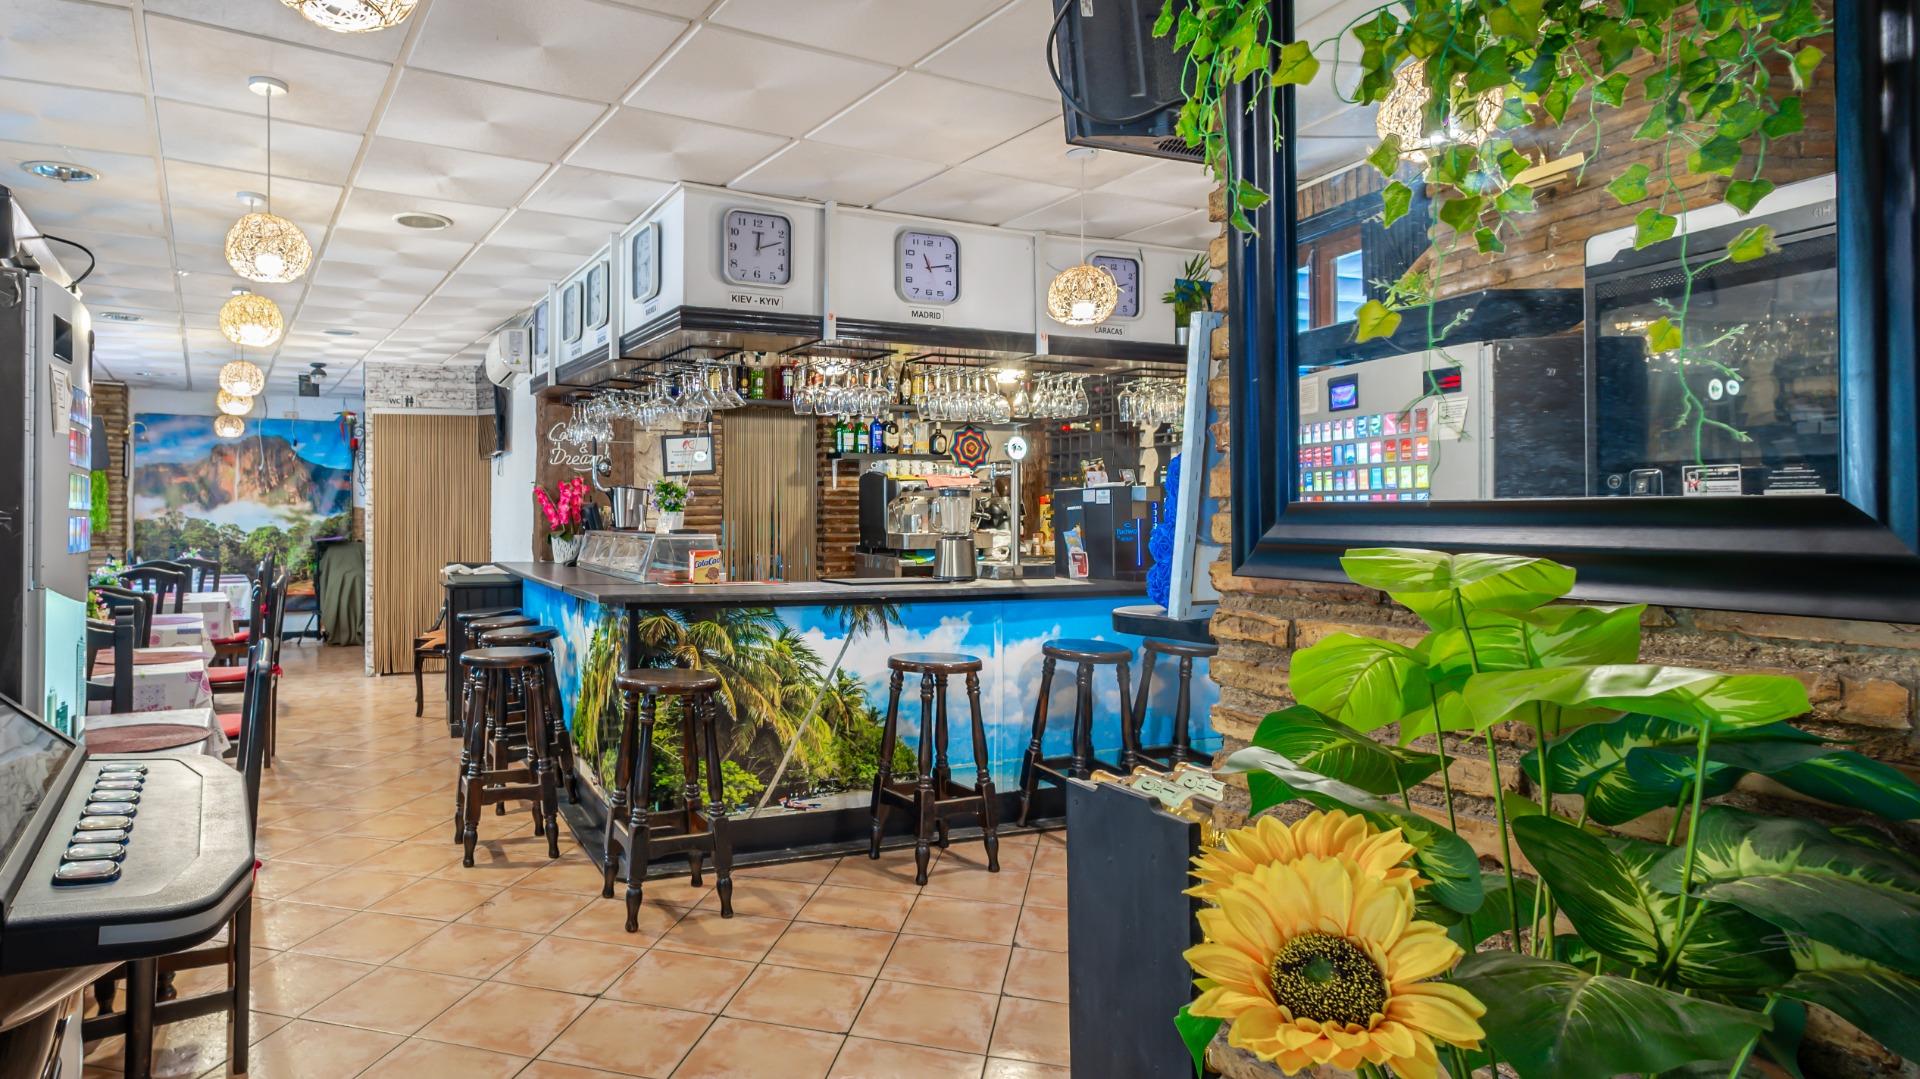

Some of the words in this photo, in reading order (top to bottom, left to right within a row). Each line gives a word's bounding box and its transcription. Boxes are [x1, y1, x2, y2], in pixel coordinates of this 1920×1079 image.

[738, 217, 746, 226] 11
[753, 219, 763, 227] 12
[771, 221, 775, 229] 1
[730, 227, 740, 236] 10
[778, 230, 785, 239] 2
[730, 242, 737, 251] 9
[778, 248, 785, 257] 3
[730, 259, 738, 268] 8
[778, 263, 784, 272] 4
[740, 269, 747, 278] 7
[753, 270, 761, 279] 6
[769, 271, 776, 281] 5
[731, 294, 752, 304] KIEV
[760, 296, 780, 306] KYIV
[911, 310, 941, 320] MADRID
[1094, 326, 1123, 336] CARACAS
[389, 397, 401, 405] WC
